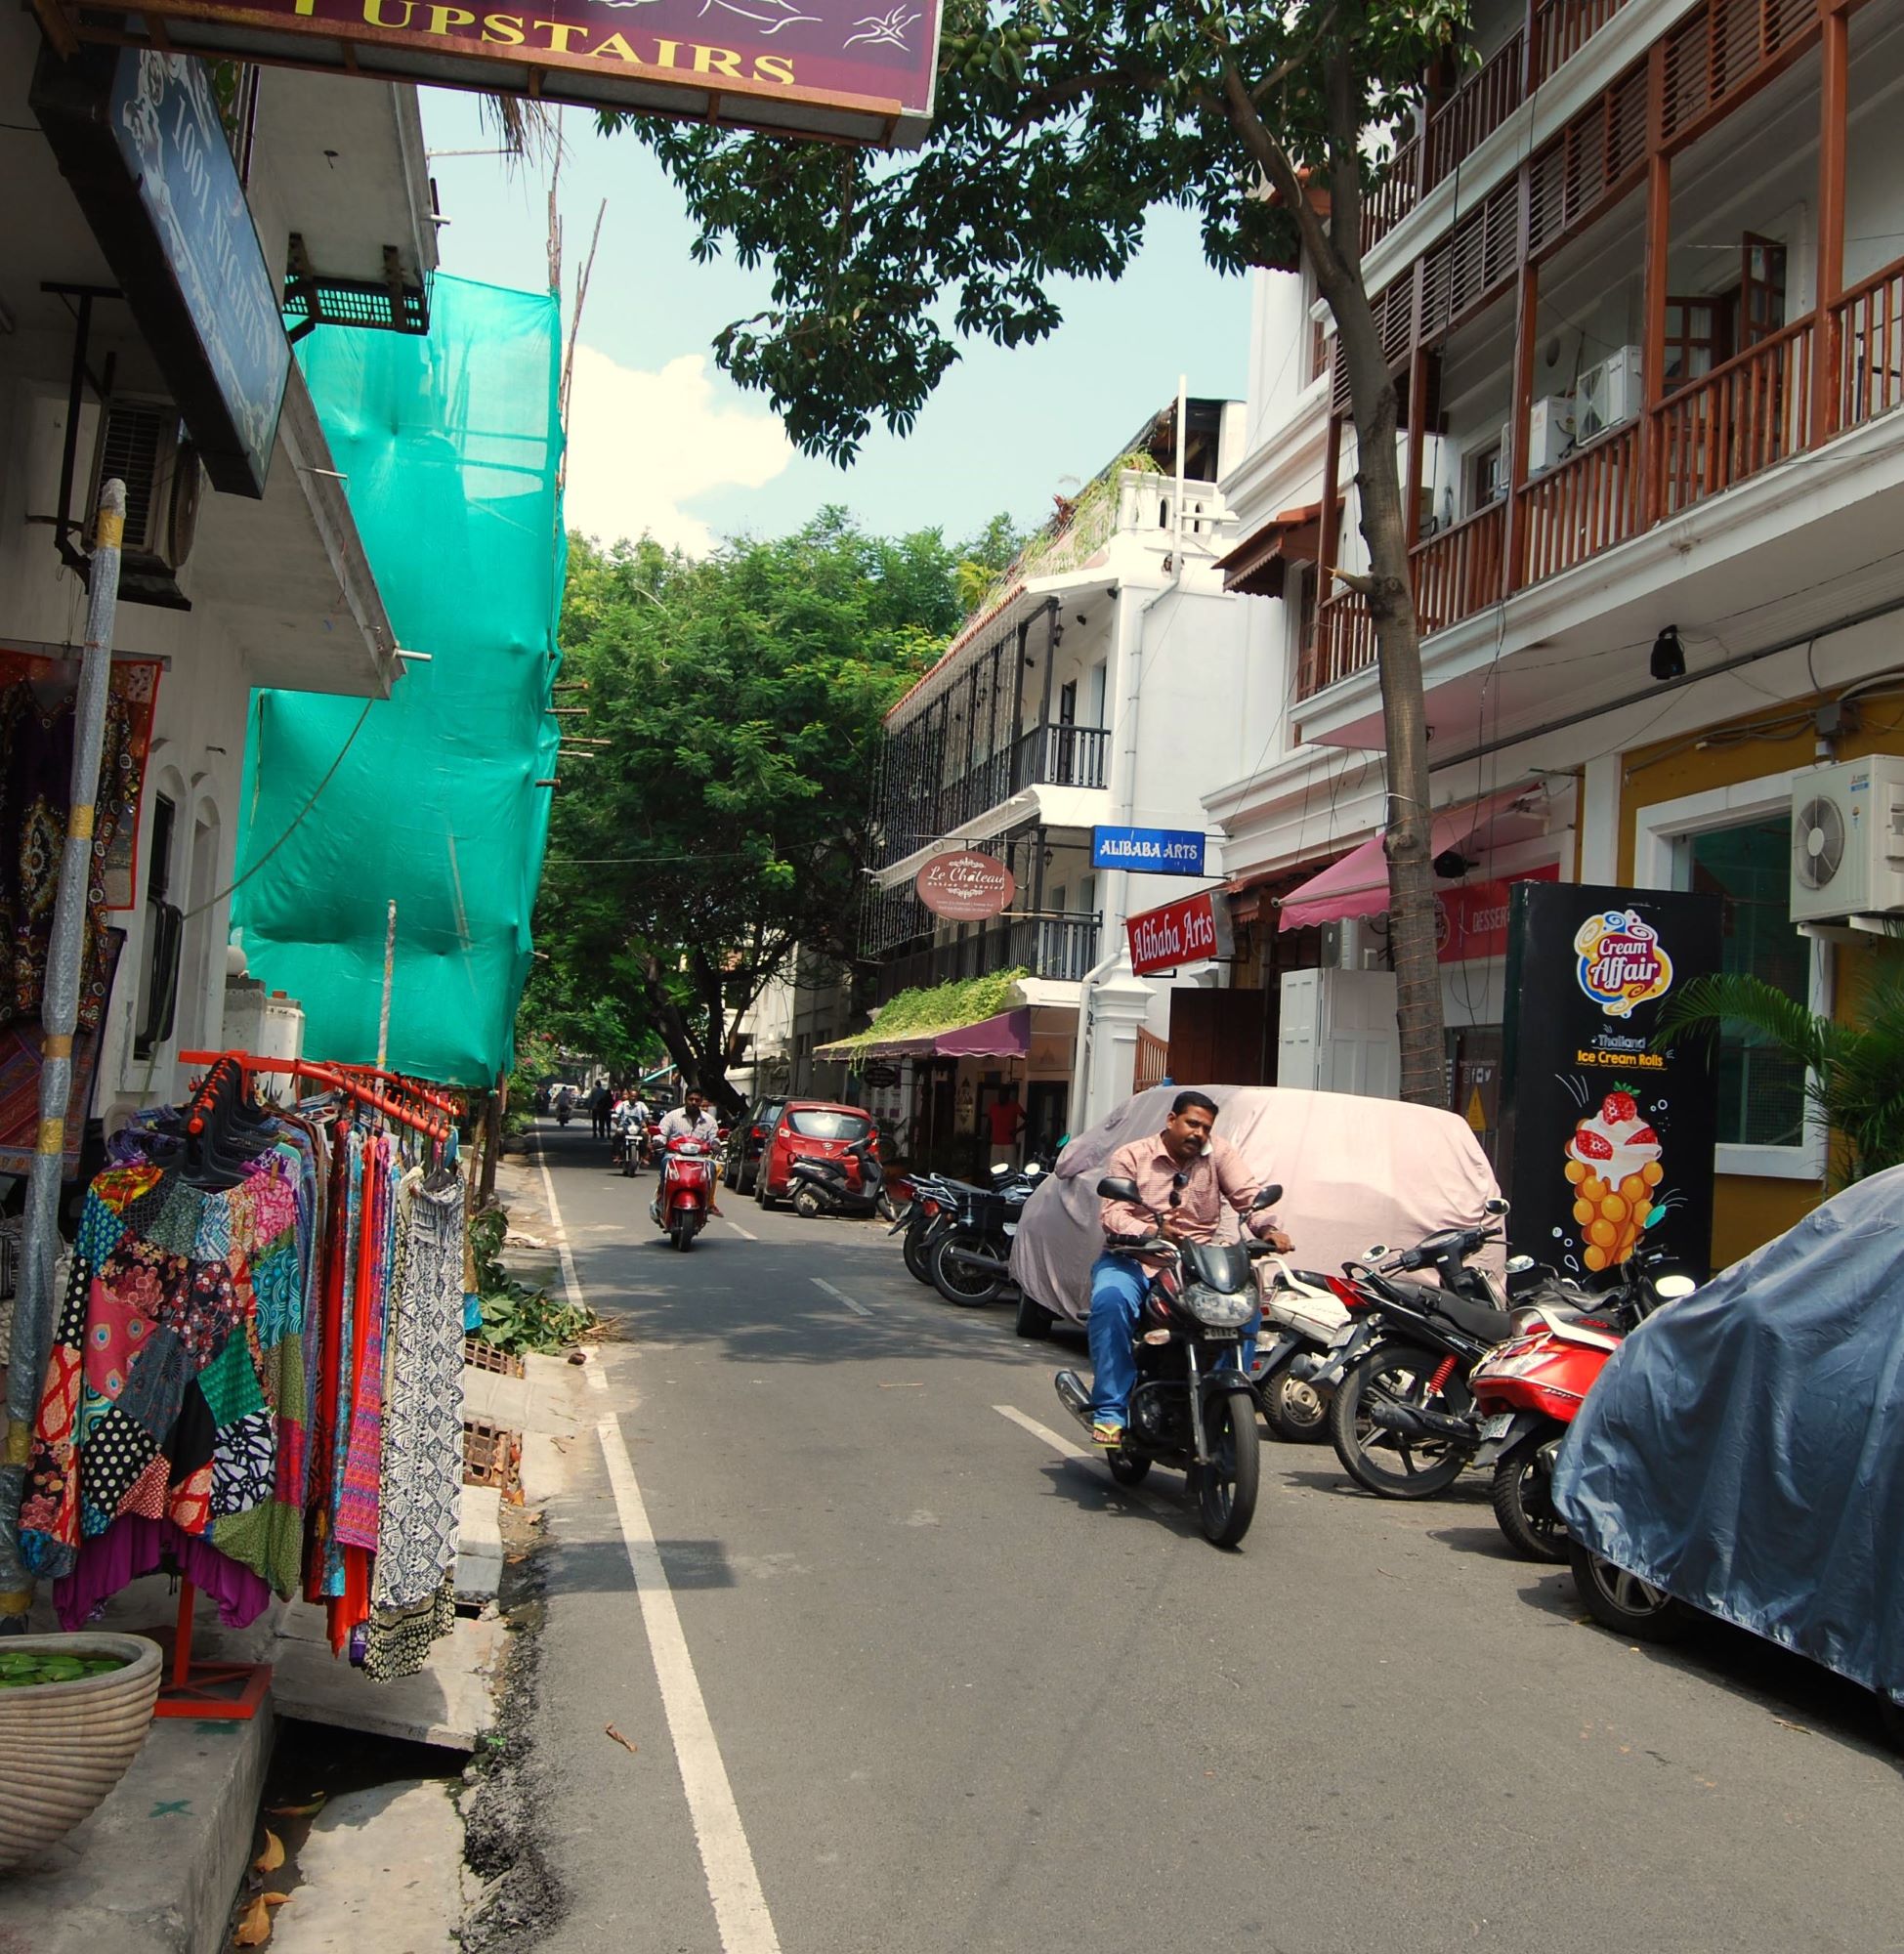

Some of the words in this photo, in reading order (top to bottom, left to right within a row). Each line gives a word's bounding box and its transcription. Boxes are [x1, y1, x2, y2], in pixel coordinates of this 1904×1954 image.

[362, 0, 796, 85] UPSTAIRS
[172, 96, 212, 221] 1001
[209, 201, 262, 367] NIGHTS
[1100, 839, 1161, 858] ALIBABA
[1163, 840, 1198, 860] ARTS
[927, 866, 945, 880] Le
[1135, 914, 1180, 964] Alibaba
[1183, 911, 1213, 957] Arts
[1599, 939, 1647, 956] Cream
[1590, 957, 1658, 988] Affair
[1597, 1034, 1646, 1048] Thailand
[1578, 1050, 1595, 1063] Ice
[1598, 1051, 1636, 1065] Cream
[1638, 1053, 1663, 1066] Rolls
